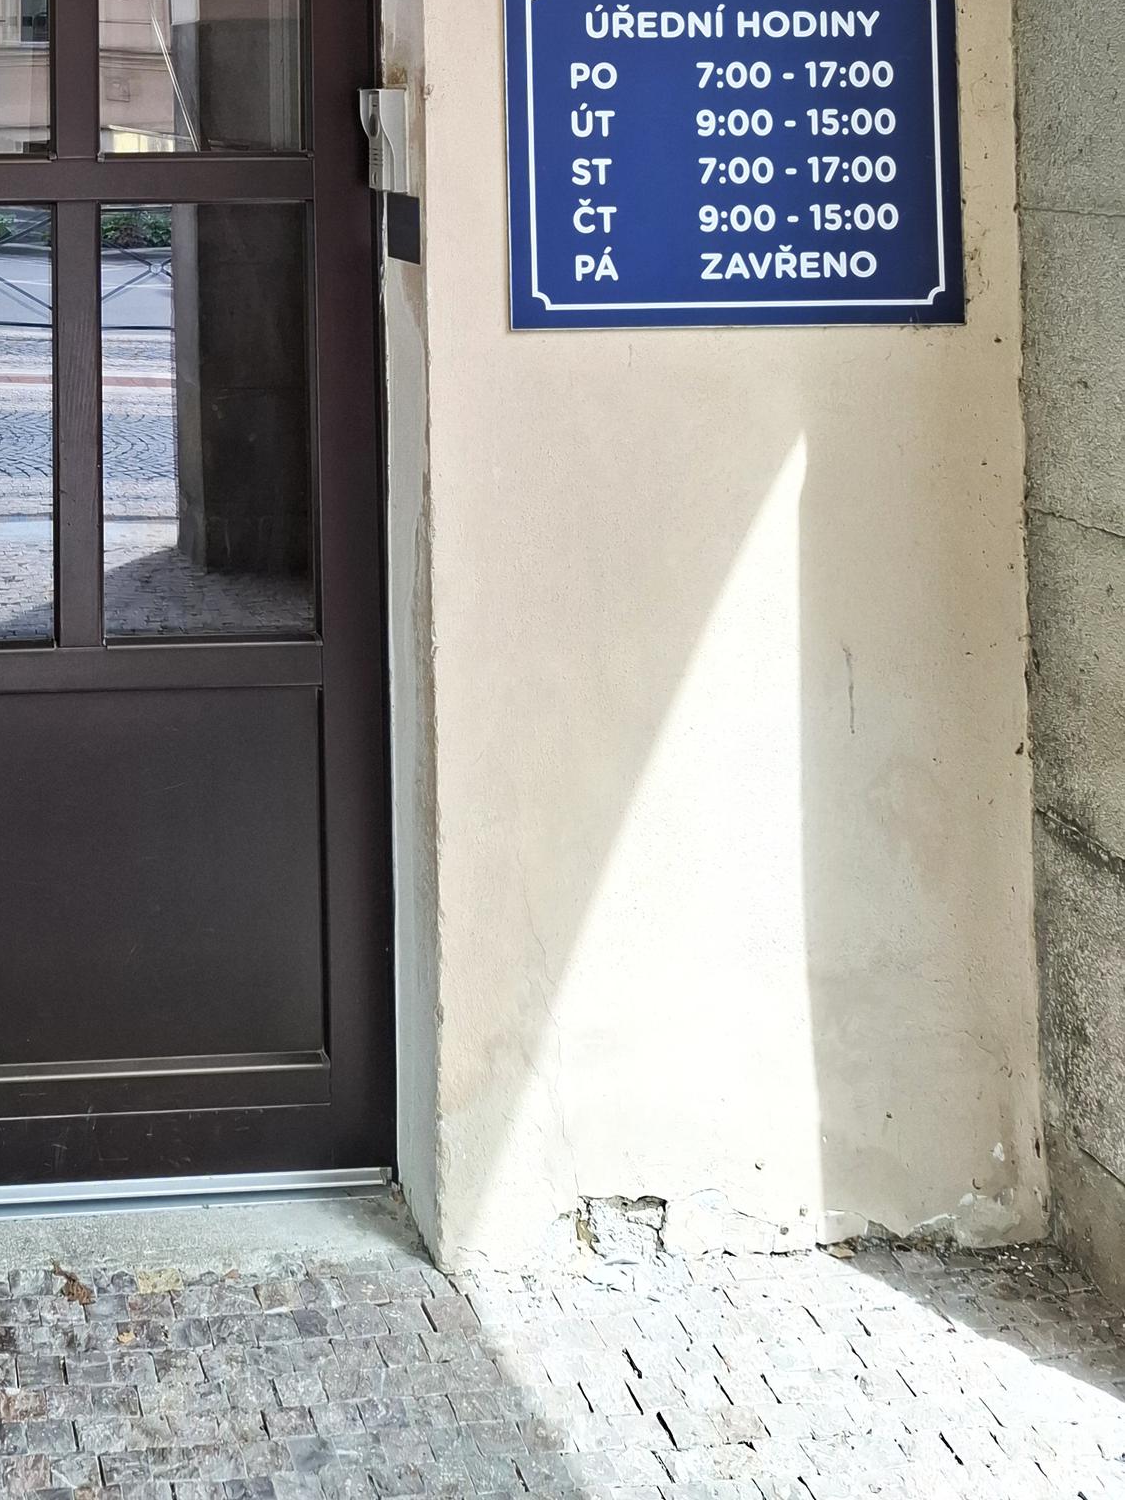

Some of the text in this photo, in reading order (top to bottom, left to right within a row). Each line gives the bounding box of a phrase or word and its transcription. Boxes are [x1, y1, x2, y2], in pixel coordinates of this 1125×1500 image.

[585, 3, 880, 39] ÚŘEDNÍ HODINY
[570, 61, 618, 90] PO
[695, 61, 772, 89] 7:00
[804, 60, 894, 88] 17:00
[570, 102, 616, 138] ÚT
[695, 108, 774, 137] 9:00
[806, 107, 896, 136] 15:00
[571, 157, 613, 186] ST
[698, 156, 774, 185] 7:00
[807, 155, 897, 184] 17:00
[572, 198, 618, 234] ČT
[698, 204, 776, 233] 9:00
[809, 202, 899, 231] 15:00
[575, 244, 877, 282] PÁ ZAVŘENO
